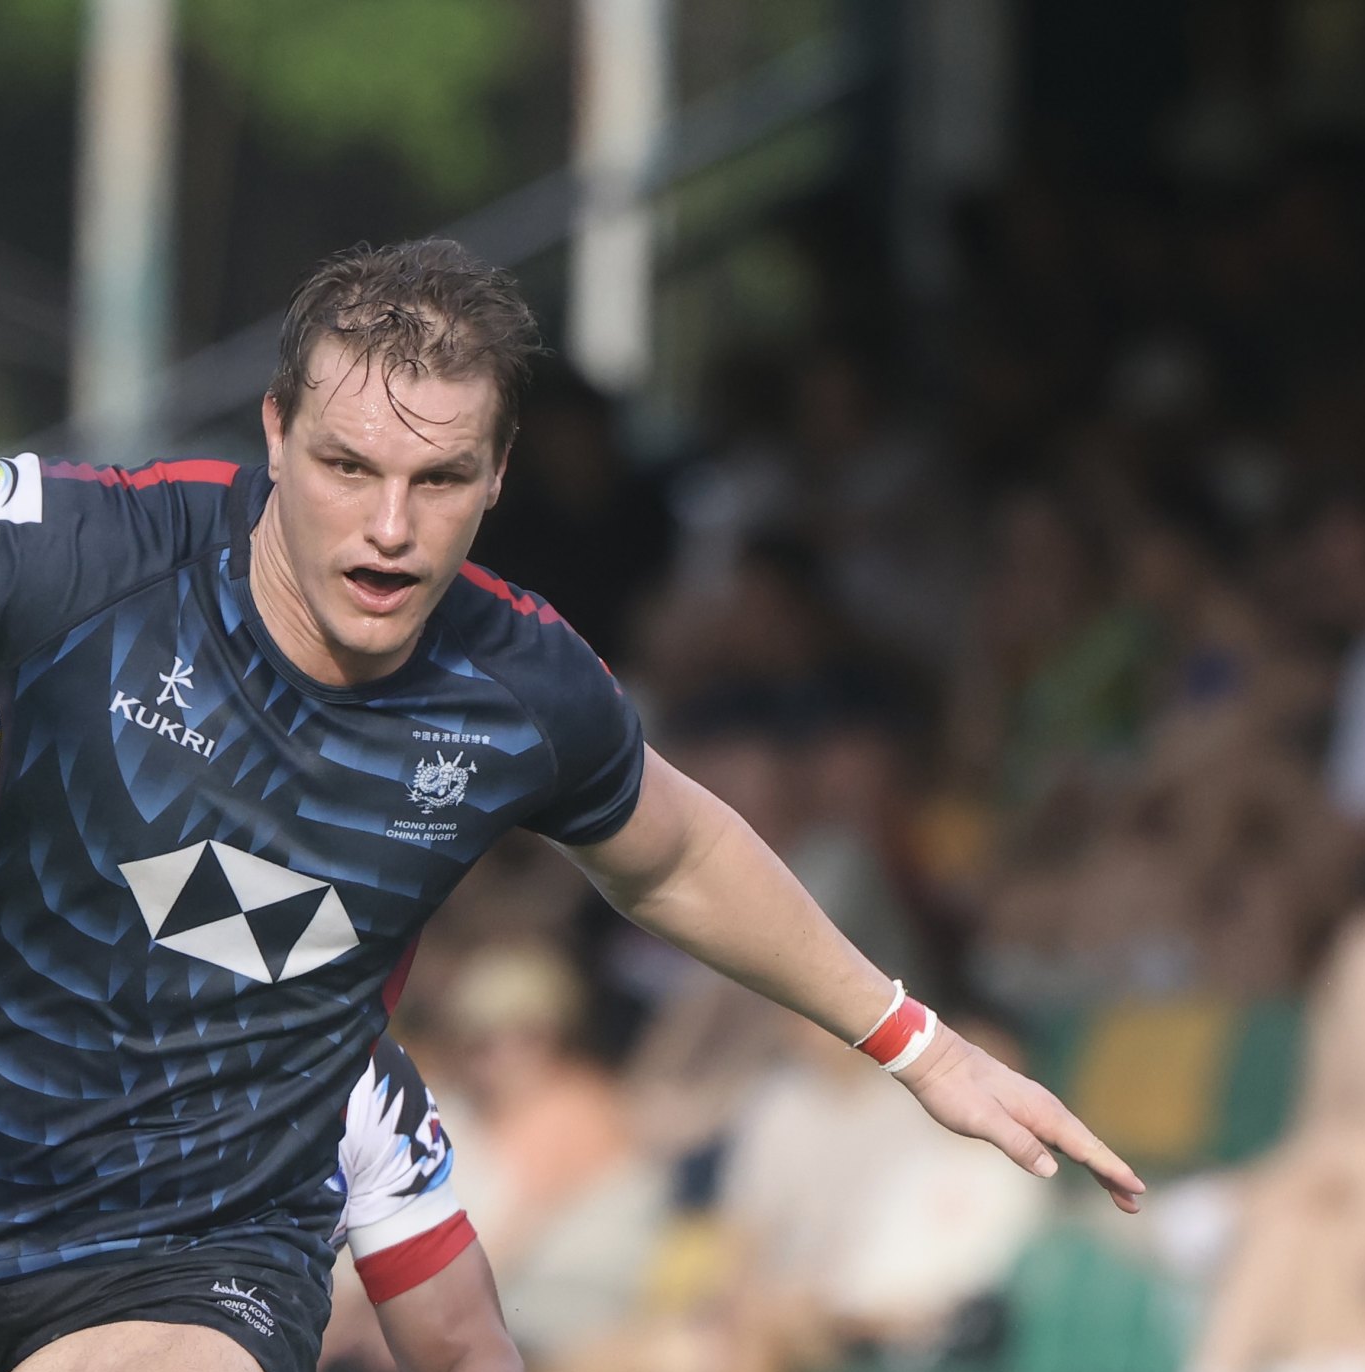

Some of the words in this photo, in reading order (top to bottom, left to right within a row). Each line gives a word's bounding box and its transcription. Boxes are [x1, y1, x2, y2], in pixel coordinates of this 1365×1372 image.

[109, 690, 215, 758] KUKRI
[386, 829, 420, 840] CHINA
[423, 833, 458, 841] RUGBY
[393, 820, 426, 831] HONG
[428, 823, 457, 831] KONG
[241, 1311, 274, 1337] RUGBY
[248, 1304, 275, 1327] KONG
